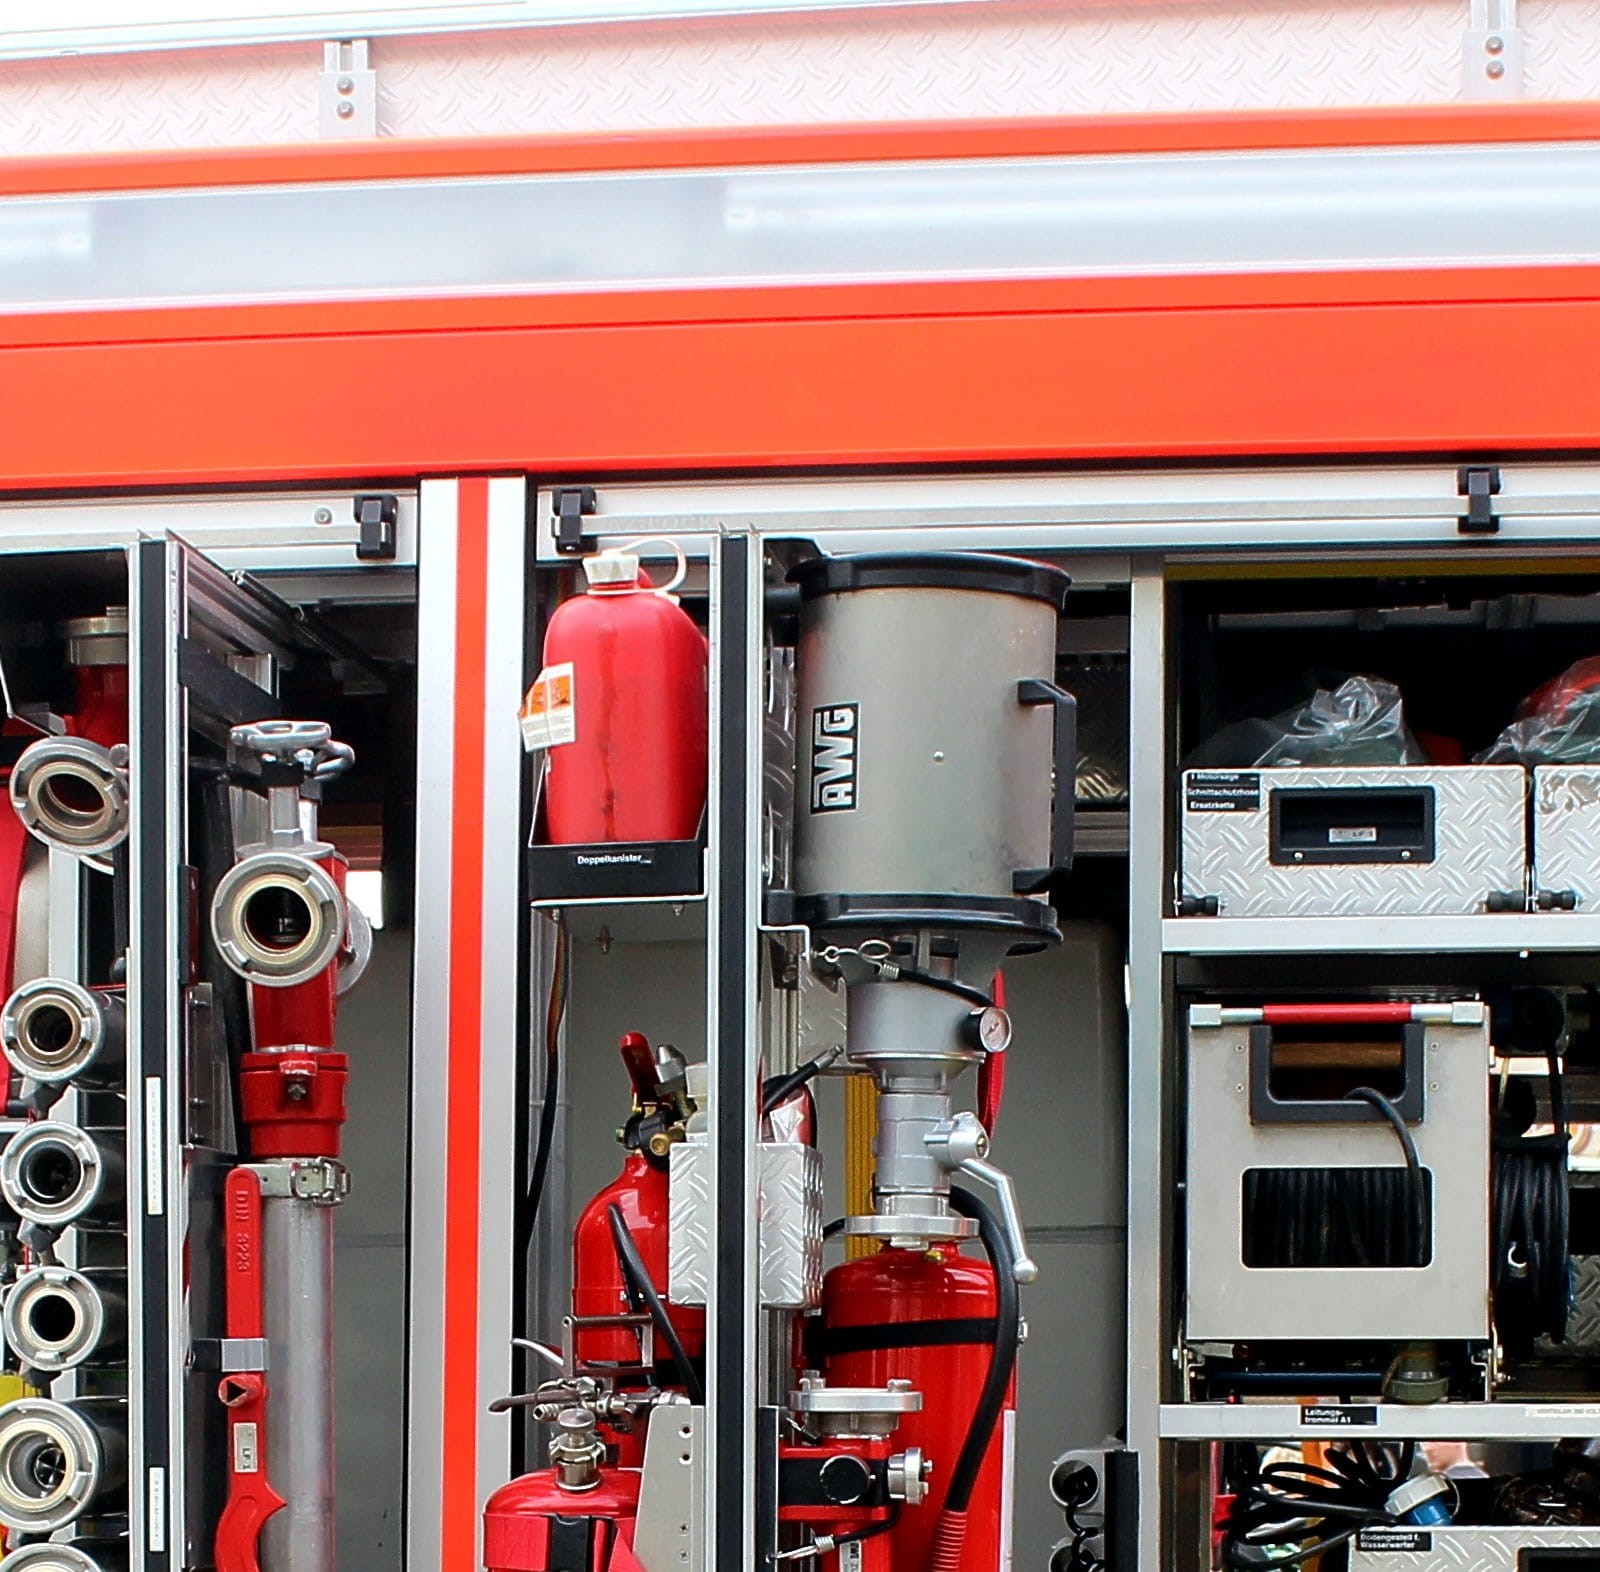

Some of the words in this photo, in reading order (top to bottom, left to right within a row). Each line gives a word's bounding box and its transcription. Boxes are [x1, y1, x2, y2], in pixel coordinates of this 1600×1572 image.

[813, 706, 854, 808] AWG
[1197, 773, 1239, 782] Motorsäge
[1187, 788, 1259, 797] Schnittschutzhose
[1190, 801, 1235, 809] Ersatzkette
[577, 853, 642, 866] Doppelkanister
[1305, 1408, 1344, 1417] Leitungs-
[1305, 1416, 1339, 1424] trommel
[1360, 1533, 1413, 1542] Bodengestell
